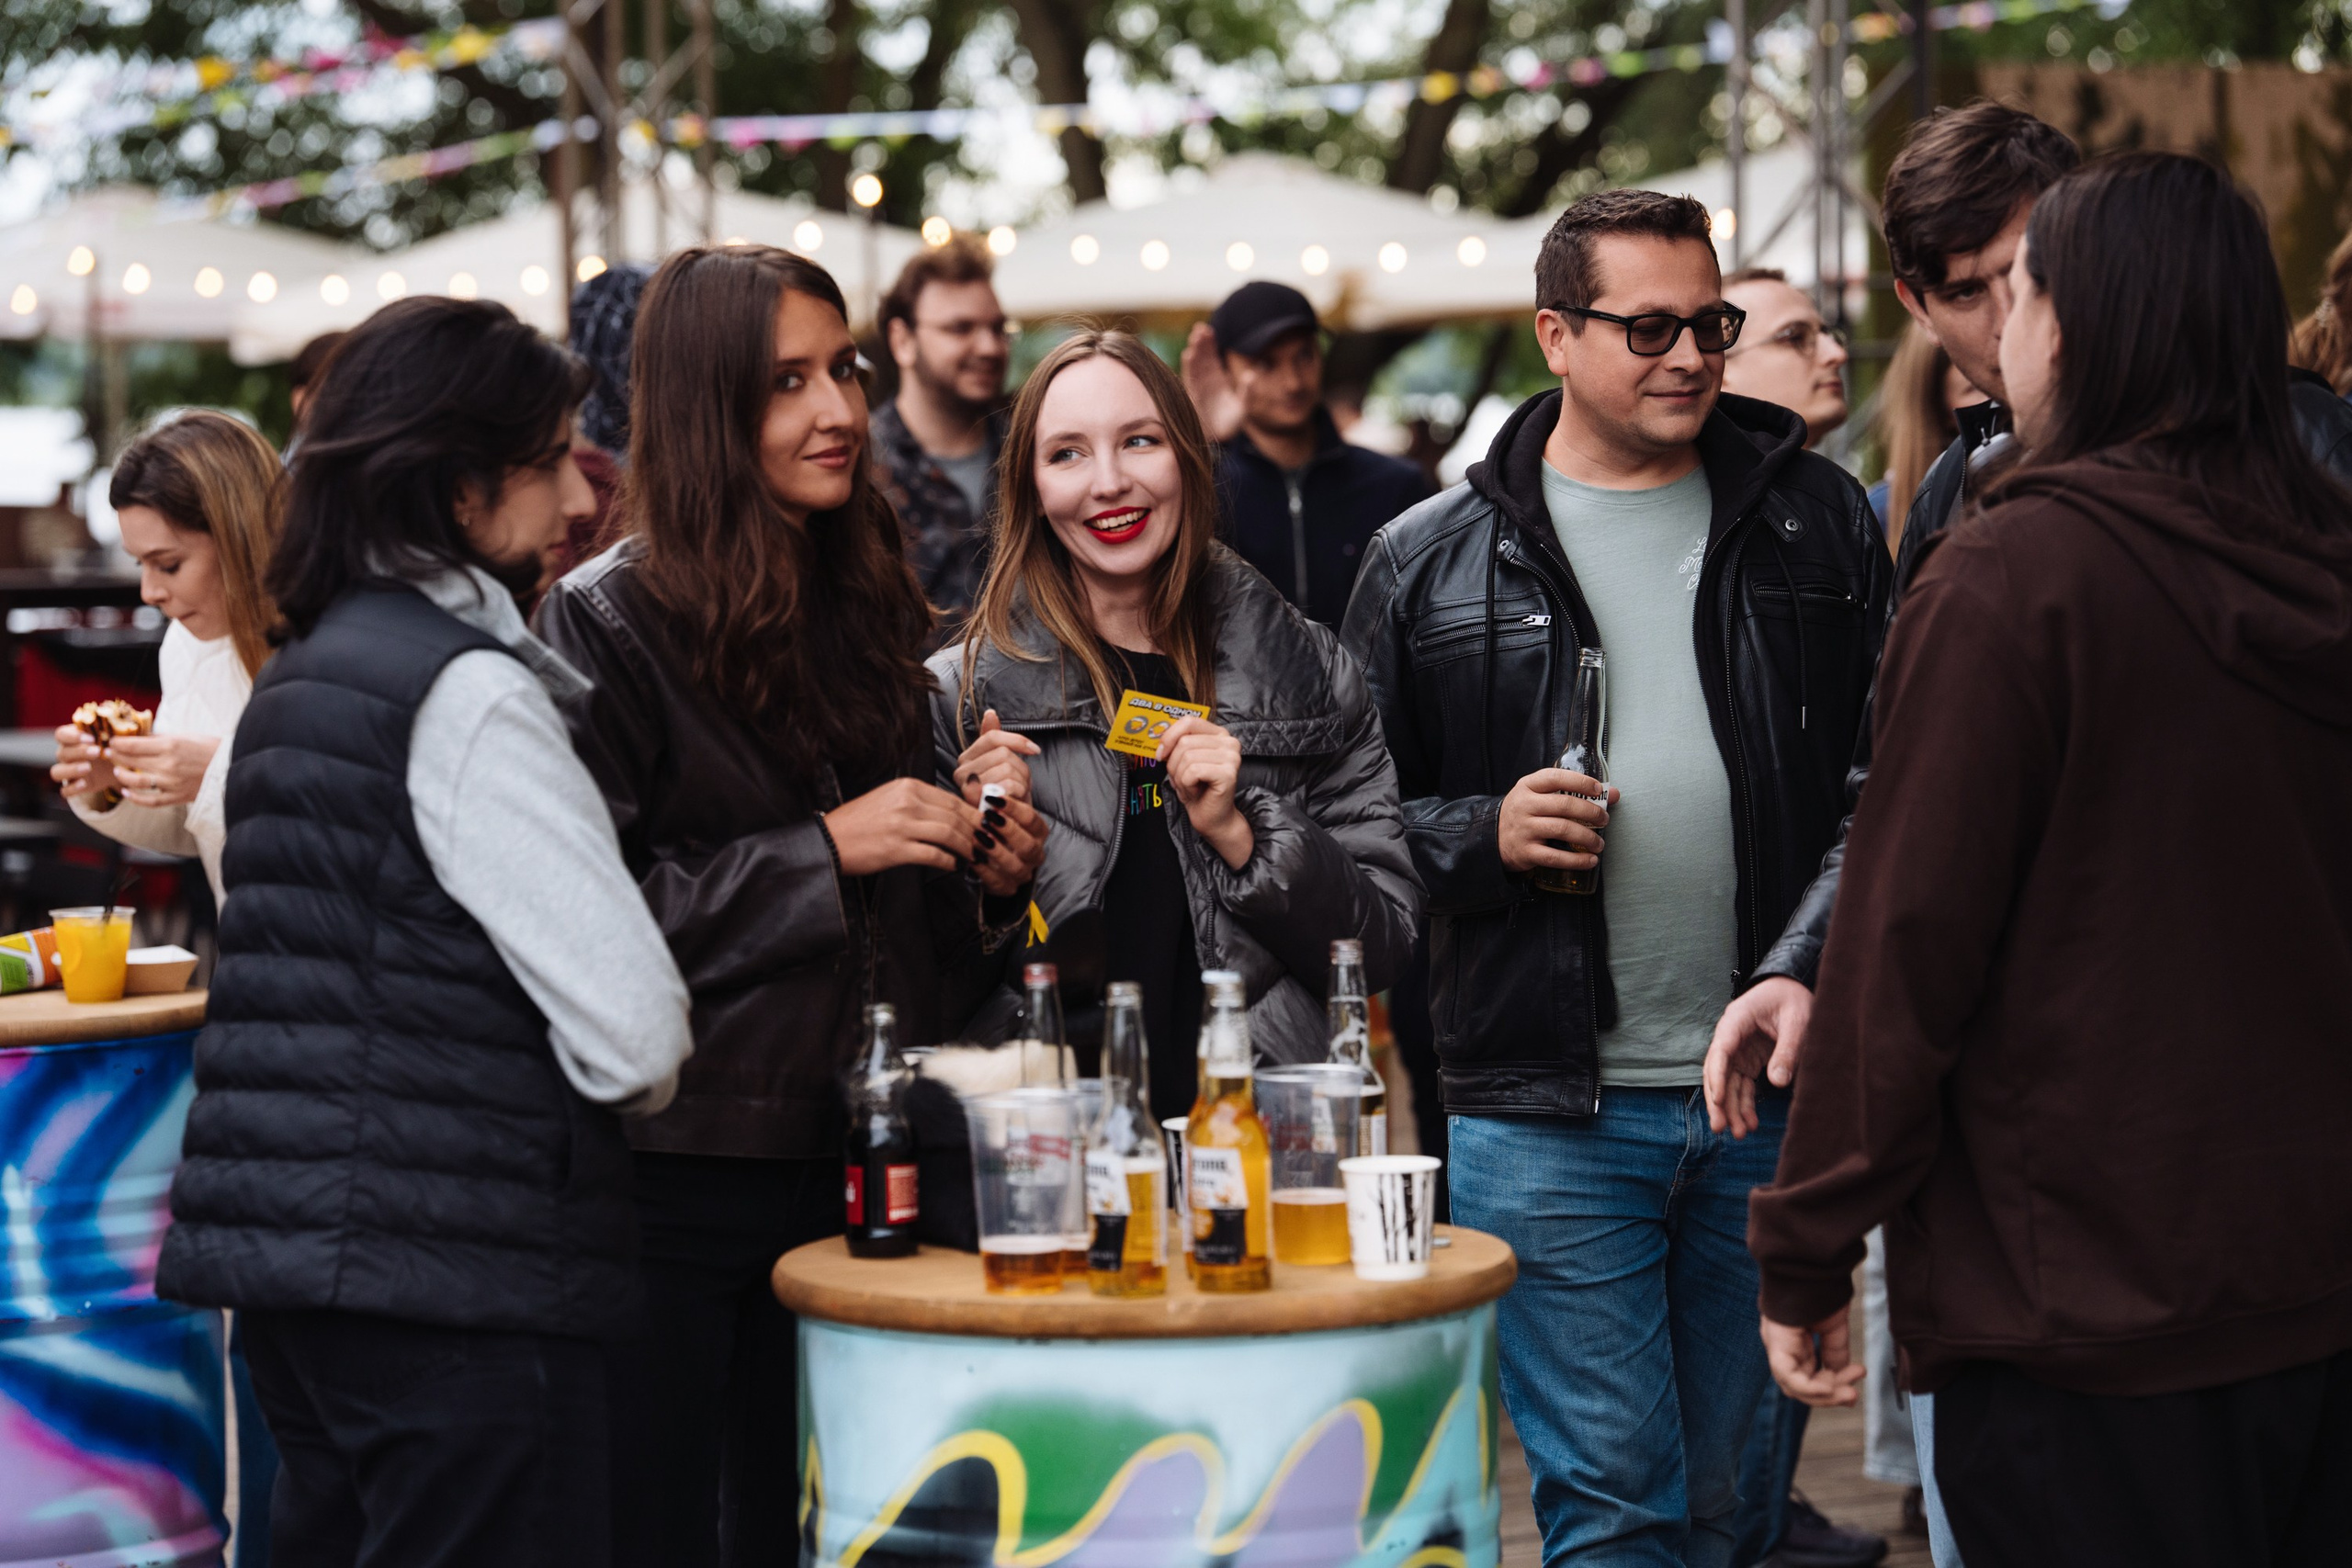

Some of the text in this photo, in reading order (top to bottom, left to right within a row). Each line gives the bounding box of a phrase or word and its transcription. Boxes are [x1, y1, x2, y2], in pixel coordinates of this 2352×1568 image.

[1128, 698, 1153, 709] ДВА
[1154, 703, 1162, 711] В
[1162, 705, 1203, 718] ОДНОМ
[1127, 784, 1162, 816] НЯТЬ
